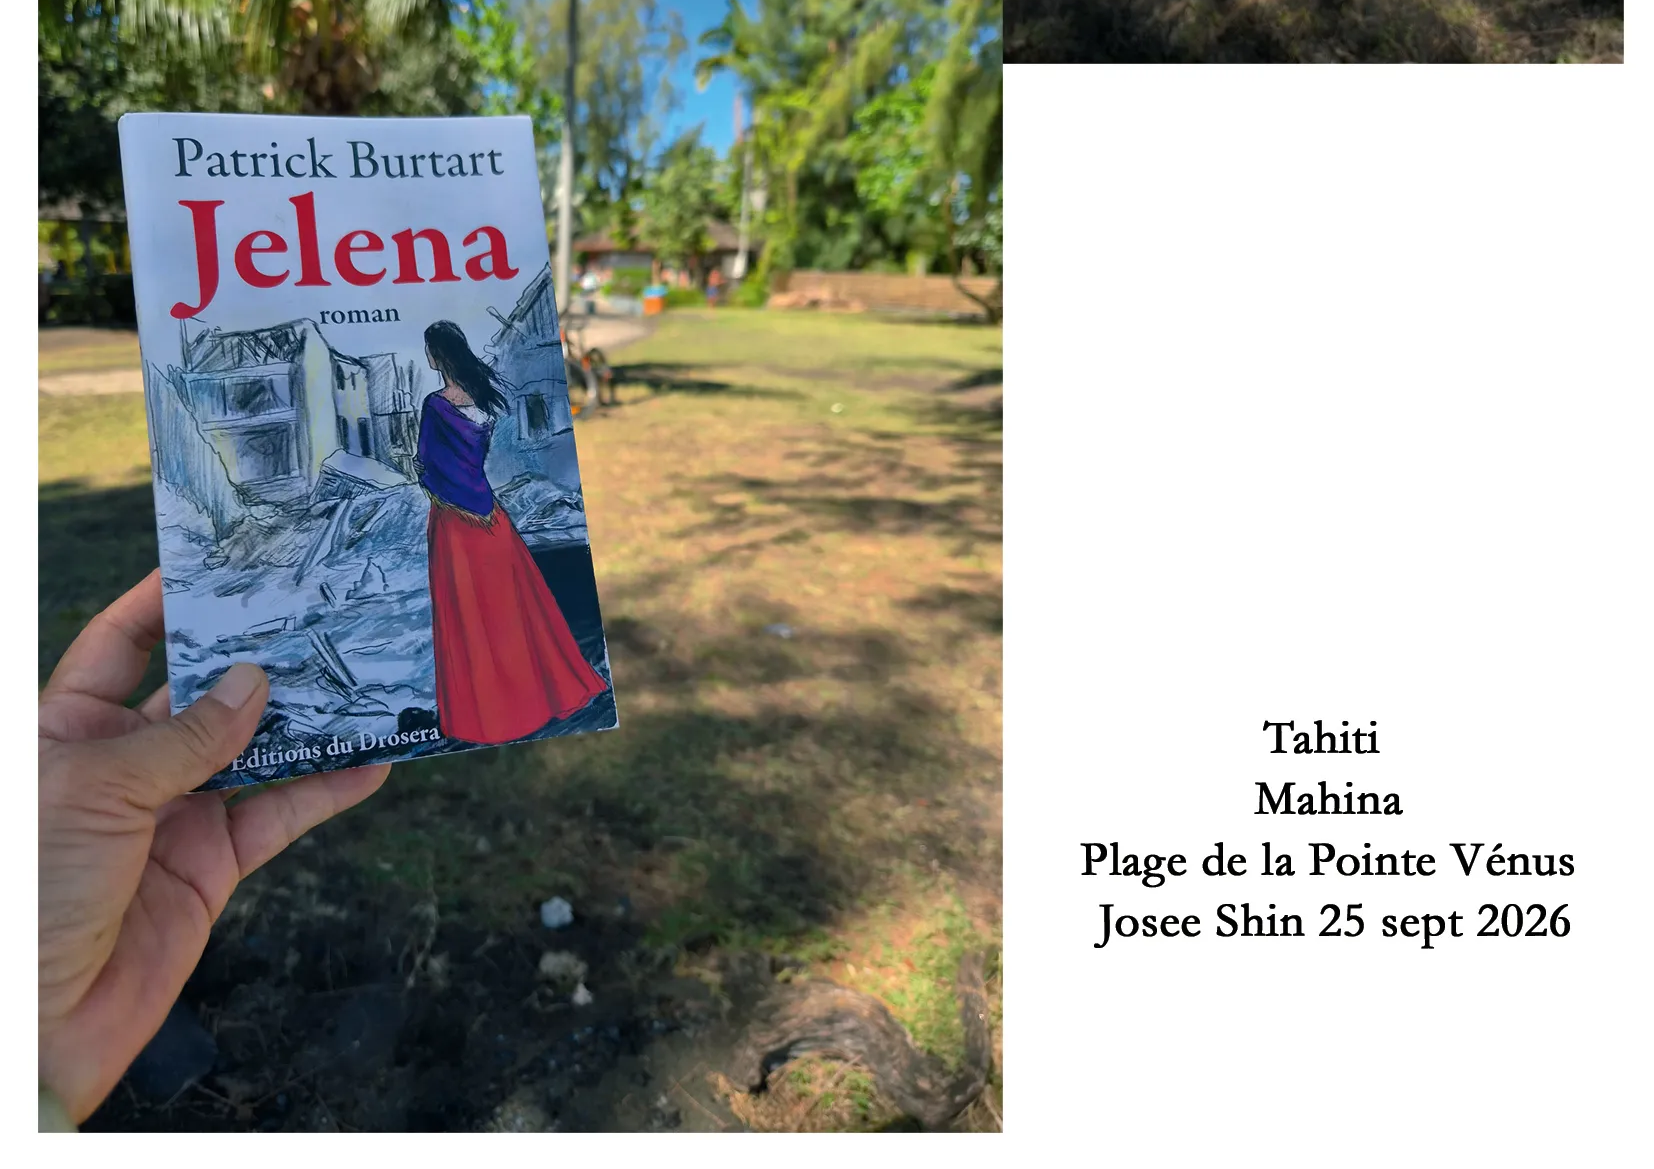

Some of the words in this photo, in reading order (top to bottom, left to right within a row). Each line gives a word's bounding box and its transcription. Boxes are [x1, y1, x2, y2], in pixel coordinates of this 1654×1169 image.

[172, 137, 337, 179] Patrick
[346, 141, 505, 179] Burtart
[169, 191, 519, 319] Jelena
[319, 308, 401, 325] roman
[326, 735, 353, 756] du
[359, 727, 440, 751] Drosera
